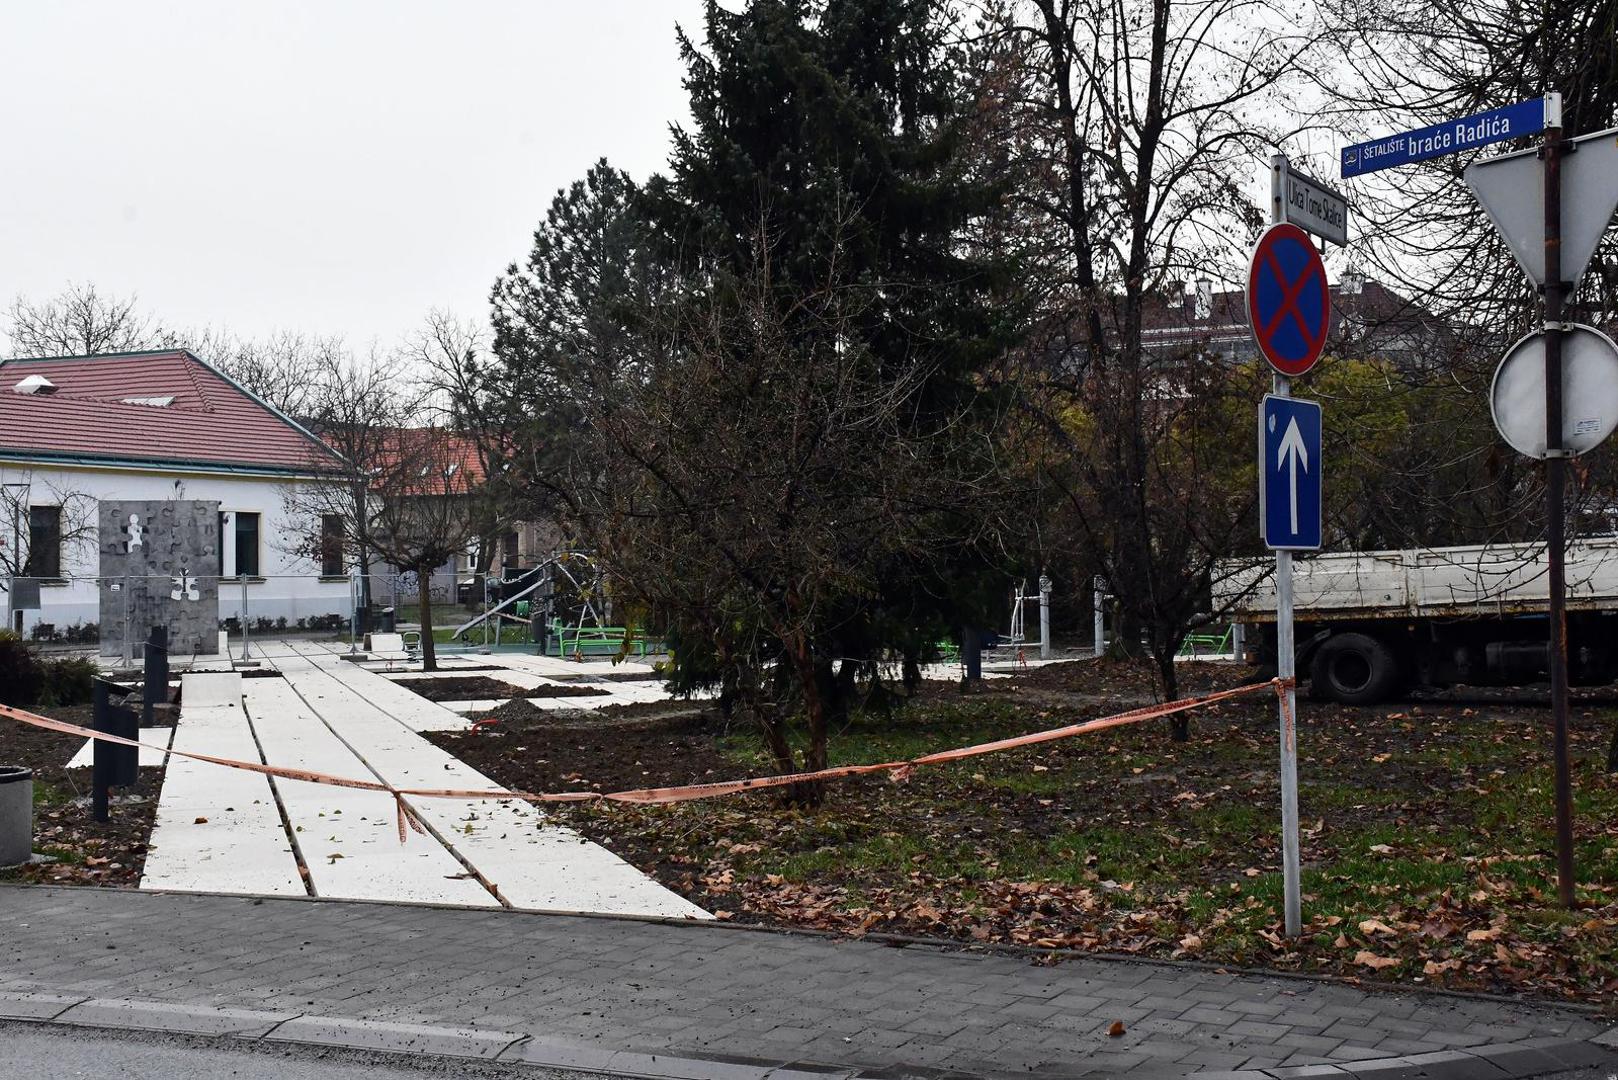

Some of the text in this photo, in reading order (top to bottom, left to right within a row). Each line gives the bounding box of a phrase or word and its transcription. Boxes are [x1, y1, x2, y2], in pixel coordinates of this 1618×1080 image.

[1363, 115, 1510, 160] ŠETALIŠTE braće Radića
[1287, 179, 1304, 210] Ulica
[1304, 188, 1322, 219] Tome
